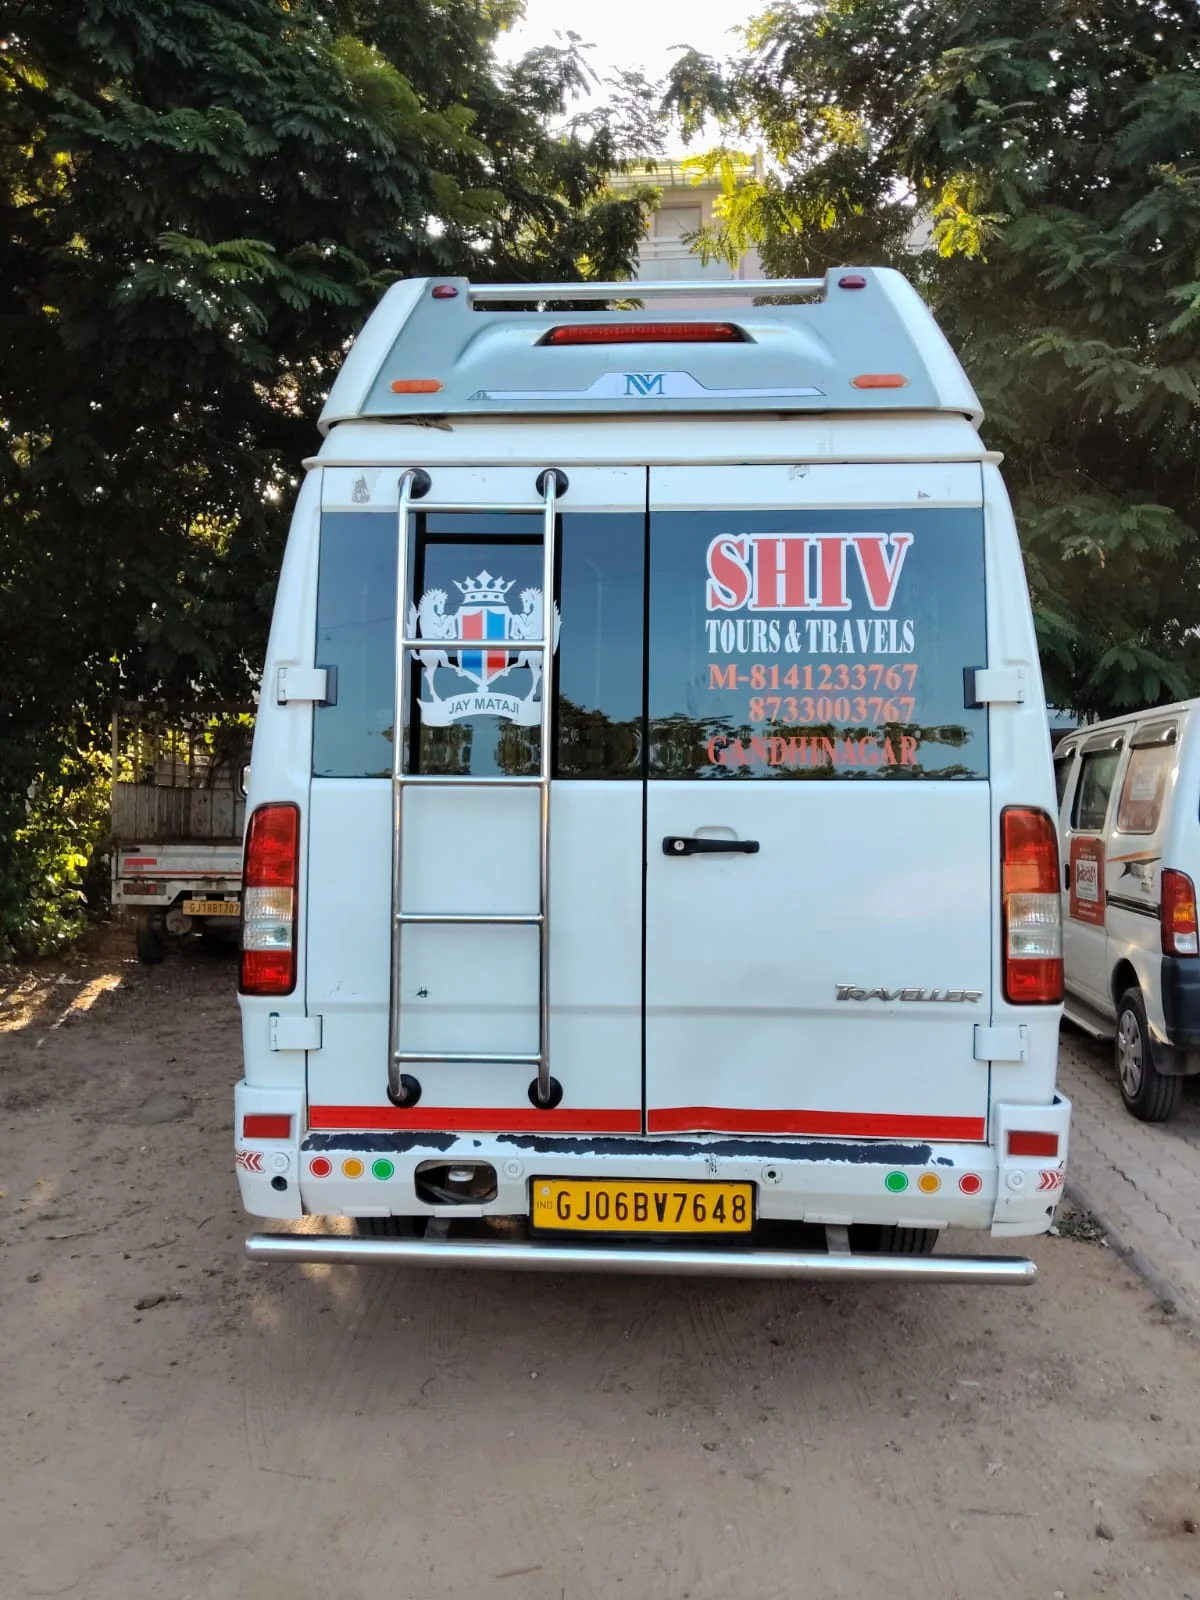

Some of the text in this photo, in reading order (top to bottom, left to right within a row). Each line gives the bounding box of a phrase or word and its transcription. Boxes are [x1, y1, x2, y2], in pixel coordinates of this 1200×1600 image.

[706, 532, 914, 612] SHIV
[705, 619, 915, 654] TOURS & TRAVELS
[707, 663, 918, 691] M-8141233767
[449, 698, 519, 715] JAY MATAJI
[749, 696, 916, 723] 8733003767
[707, 735, 919, 766] GANDHINAGAR
[537, 1190, 747, 1223] IND GJ06BV7648
